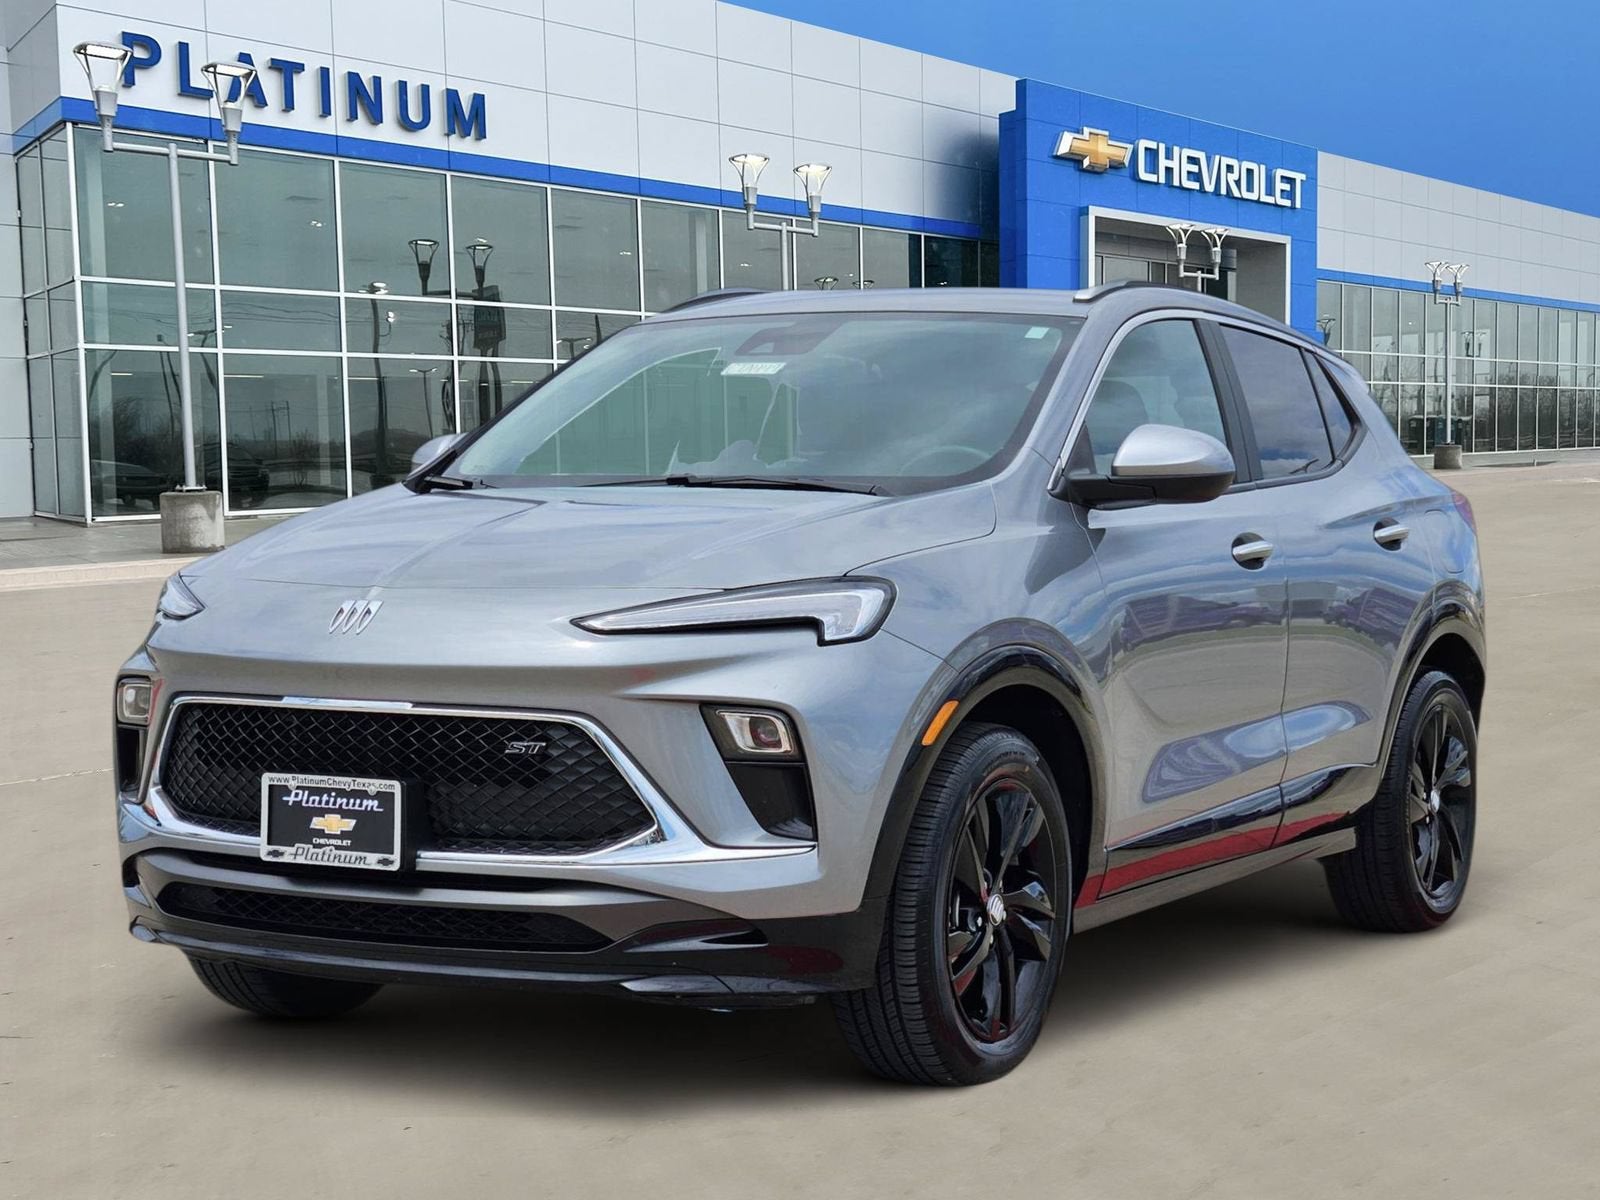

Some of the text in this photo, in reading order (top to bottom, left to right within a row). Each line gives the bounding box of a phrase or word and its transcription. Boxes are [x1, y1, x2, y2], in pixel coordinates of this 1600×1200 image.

[121, 31, 487, 140] PLATINUM
[1136, 139, 1306, 208] CHEVROLET
[504, 741, 546, 754] ST
[268, 776, 395, 791] wwwPlatinumChevyTexas.com
[282, 790, 384, 811] Platinum
[312, 837, 352, 846] CHEVROLET
[290, 847, 372, 866] Platinum
